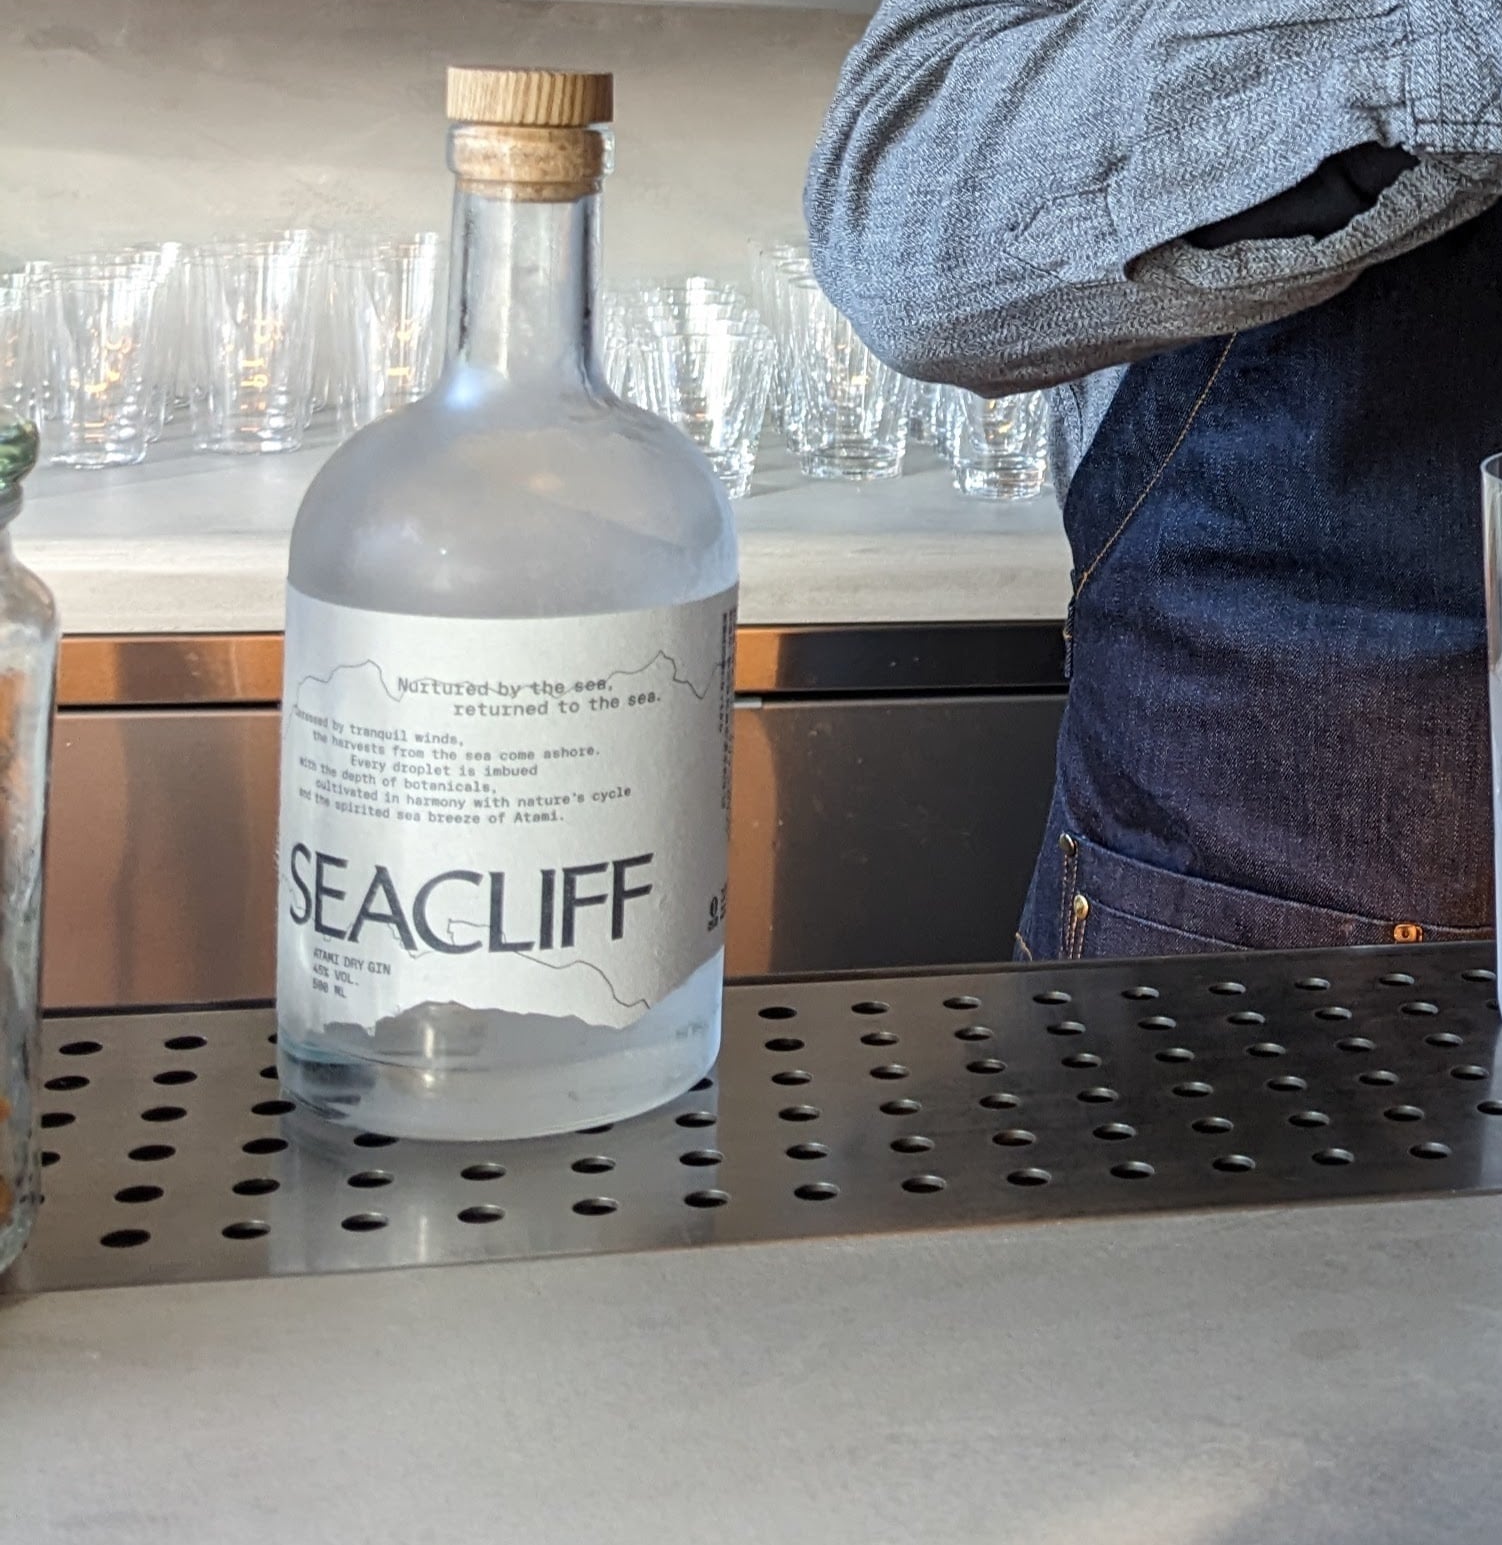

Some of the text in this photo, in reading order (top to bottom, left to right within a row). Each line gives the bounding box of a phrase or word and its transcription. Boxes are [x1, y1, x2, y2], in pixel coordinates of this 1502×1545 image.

[397, 677, 613, 700] Nurtured by the sea,
[453, 691, 662, 718] returned to the sea.
[313, 730, 601, 762] the harvests from the sea come ashore.
[331, 718, 345, 734] by
[350, 723, 408, 742] tranquil
[414, 732, 464, 748] winds,
[299, 756, 497, 795] with the depth of botanicals,
[350, 754, 539, 778] Every droplet is imbued
[315, 778, 633, 810] cultivated in harmony with nature's cycle
[315, 793, 330, 807] the
[335, 799, 391, 819] spirited
[396, 809, 422, 823] sea
[428, 810, 481, 825] breeze
[487, 811, 506, 824] of
[513, 809, 565, 824] Atami.
[288, 841, 655, 956] SEACLIFF
[312, 947, 392, 976] ATAMI DRY GIN
[333, 969, 360, 987] VOL.
